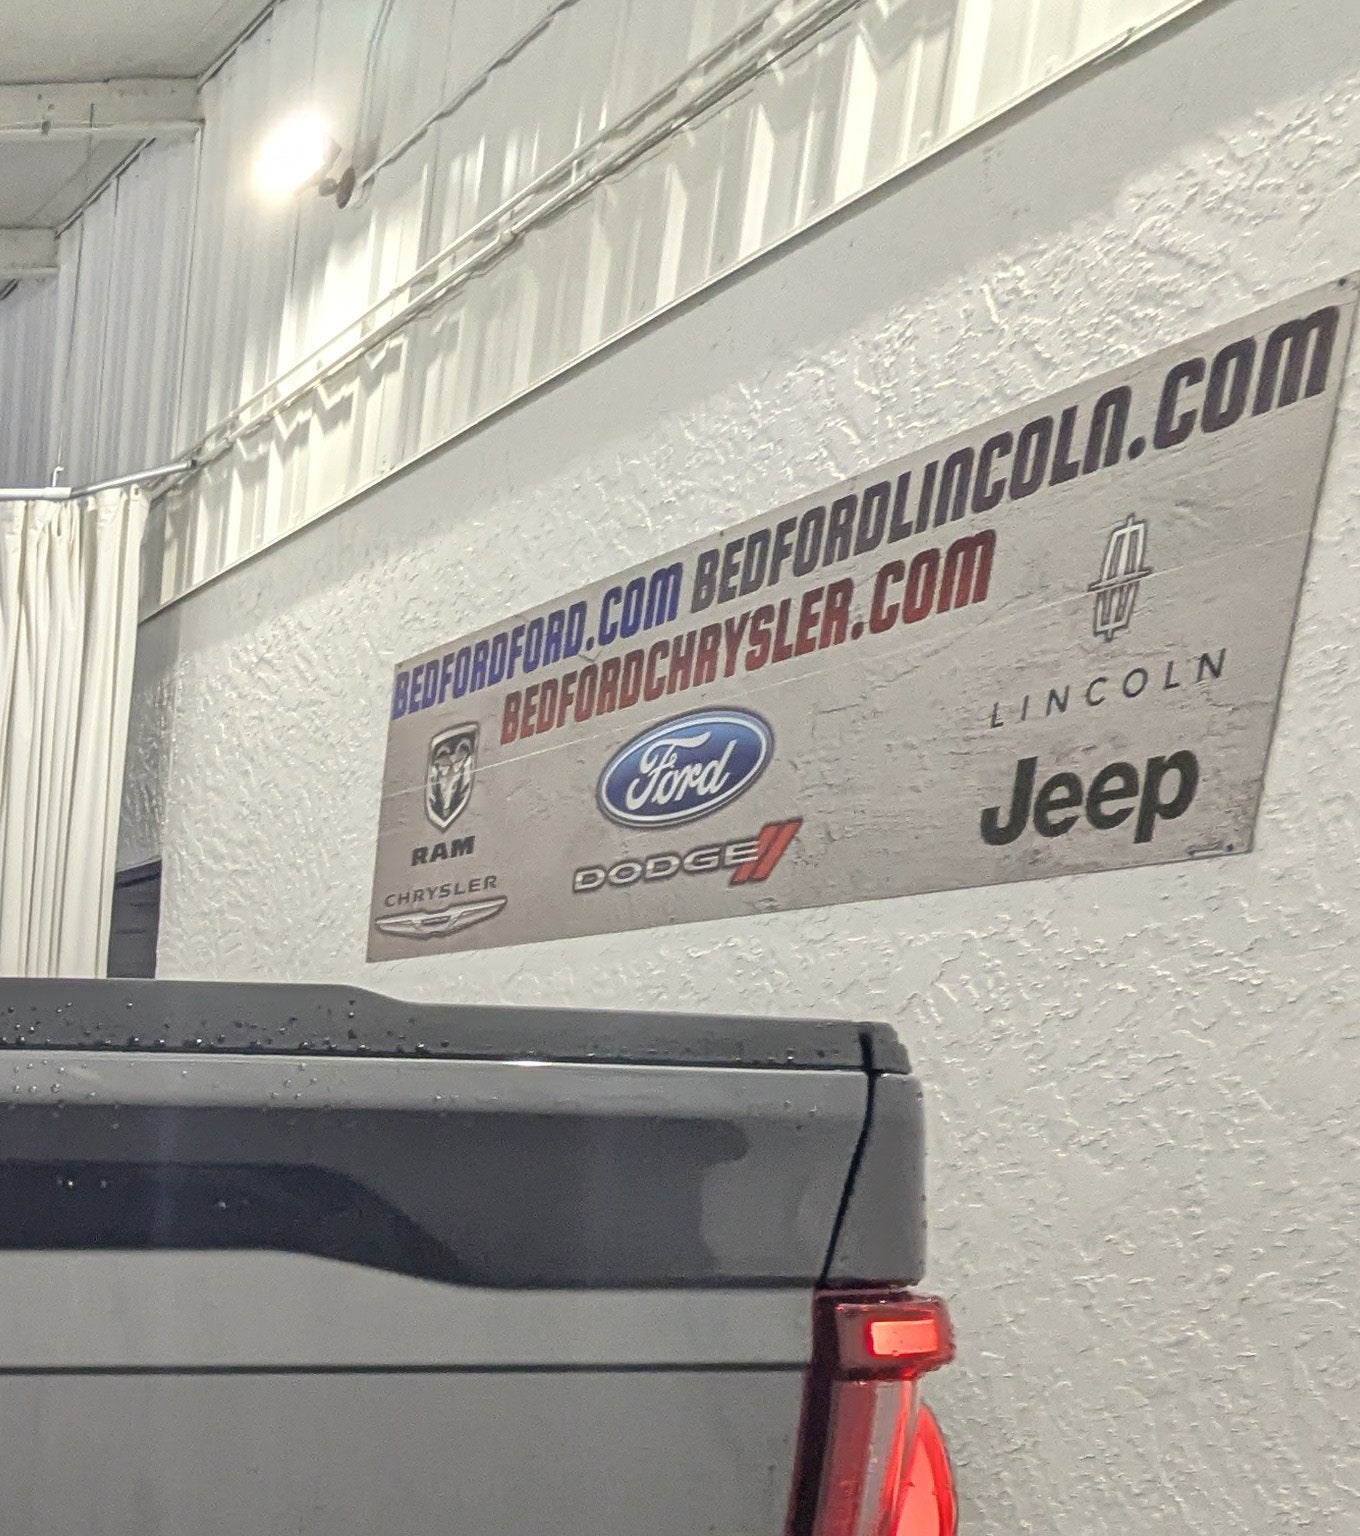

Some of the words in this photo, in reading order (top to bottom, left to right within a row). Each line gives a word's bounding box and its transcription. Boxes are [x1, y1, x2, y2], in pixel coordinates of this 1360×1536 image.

[392, 562, 683, 720] BEDFORDFORD.COM
[690, 305, 1340, 614] BEDFORDLINCOLN.COM
[500, 529, 996, 746] BEDFORDCHRYSLER.COM
[990, 648, 1226, 729] LINCOLN
[625, 731, 738, 811] Ford
[980, 750, 1199, 846] Jeep
[411, 835, 476, 867] RAM
[573, 839, 761, 893] DODGE
[384, 875, 498, 909] CHRYSLER
